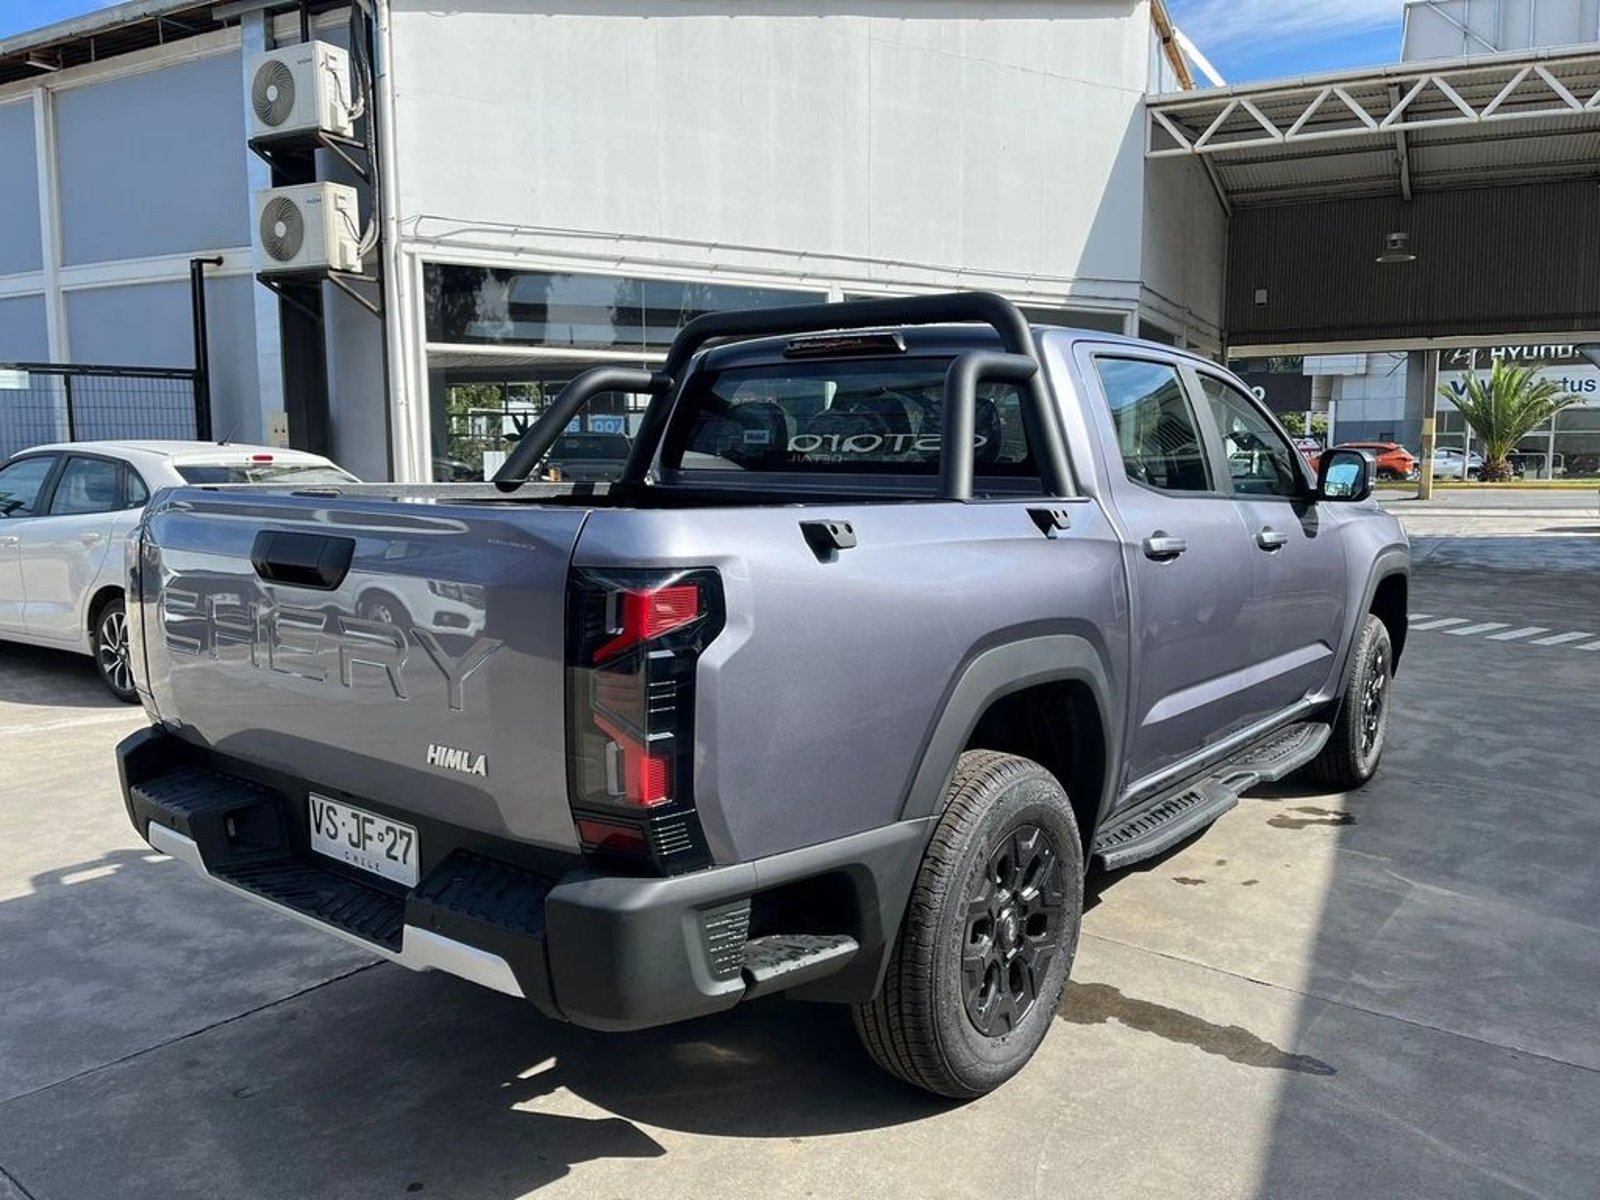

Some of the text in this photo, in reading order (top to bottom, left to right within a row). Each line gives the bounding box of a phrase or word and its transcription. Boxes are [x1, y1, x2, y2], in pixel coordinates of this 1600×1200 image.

[1491, 345, 1581, 361] HYUND
[158, 587, 503, 711] CHERY
[427, 744, 488, 776] HIMLA
